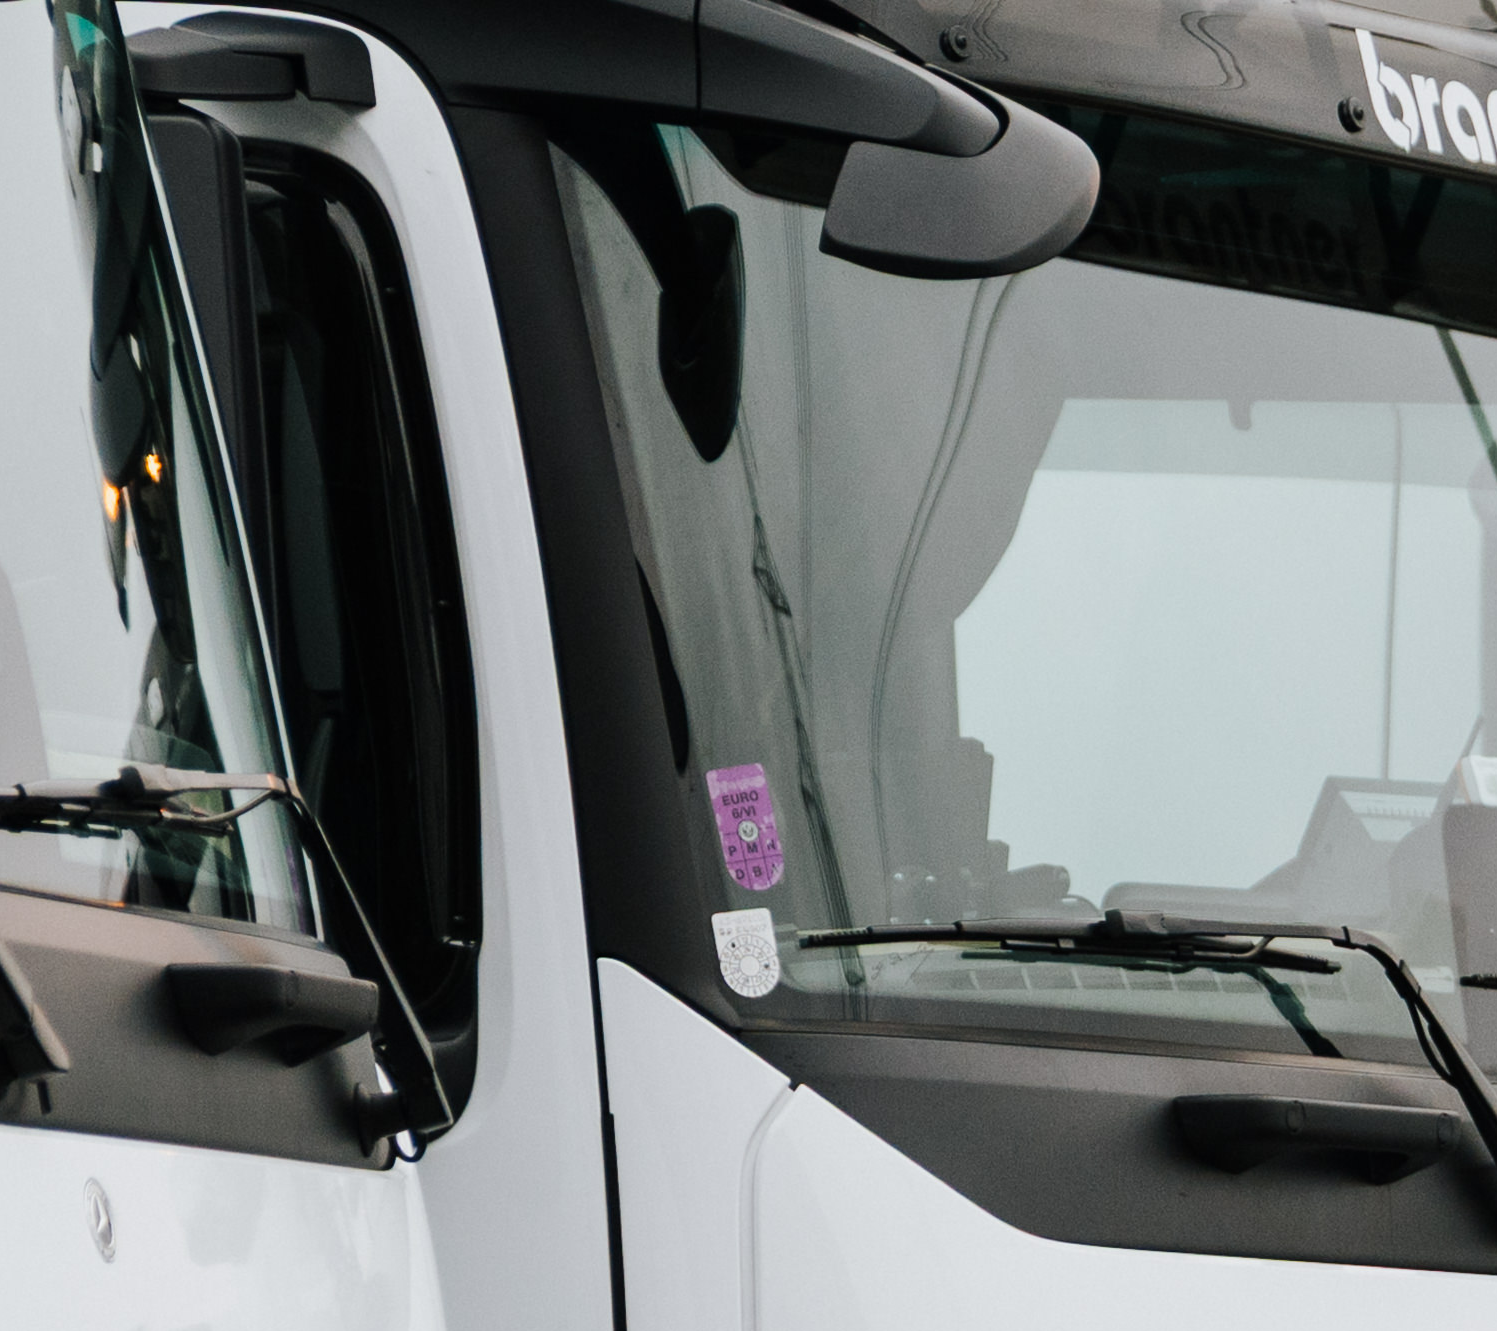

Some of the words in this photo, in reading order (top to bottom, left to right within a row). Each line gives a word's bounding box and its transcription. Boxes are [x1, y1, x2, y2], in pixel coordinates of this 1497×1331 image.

[722, 790, 759, 806] EURO
[731, 806, 756, 819] 6/VI
[728, 845, 737, 857] P
[746, 842, 759, 854] M
